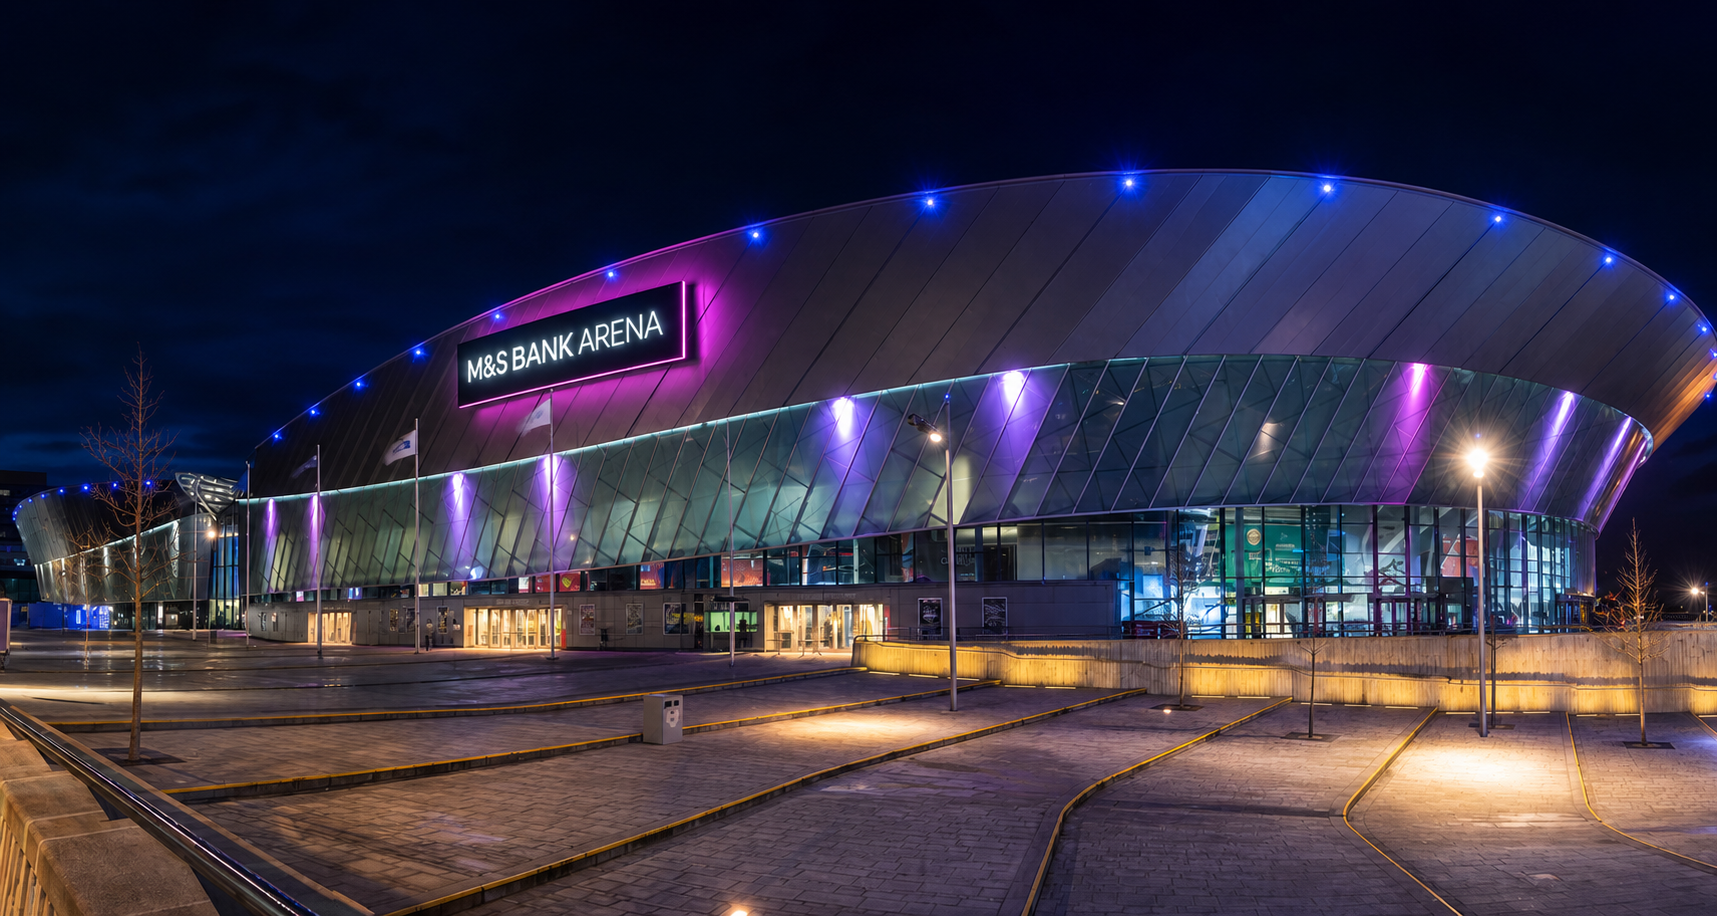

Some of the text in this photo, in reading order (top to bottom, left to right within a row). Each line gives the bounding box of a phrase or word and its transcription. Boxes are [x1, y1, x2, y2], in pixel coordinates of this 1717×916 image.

[467, 310, 664, 383] M&S BANK ARENA
